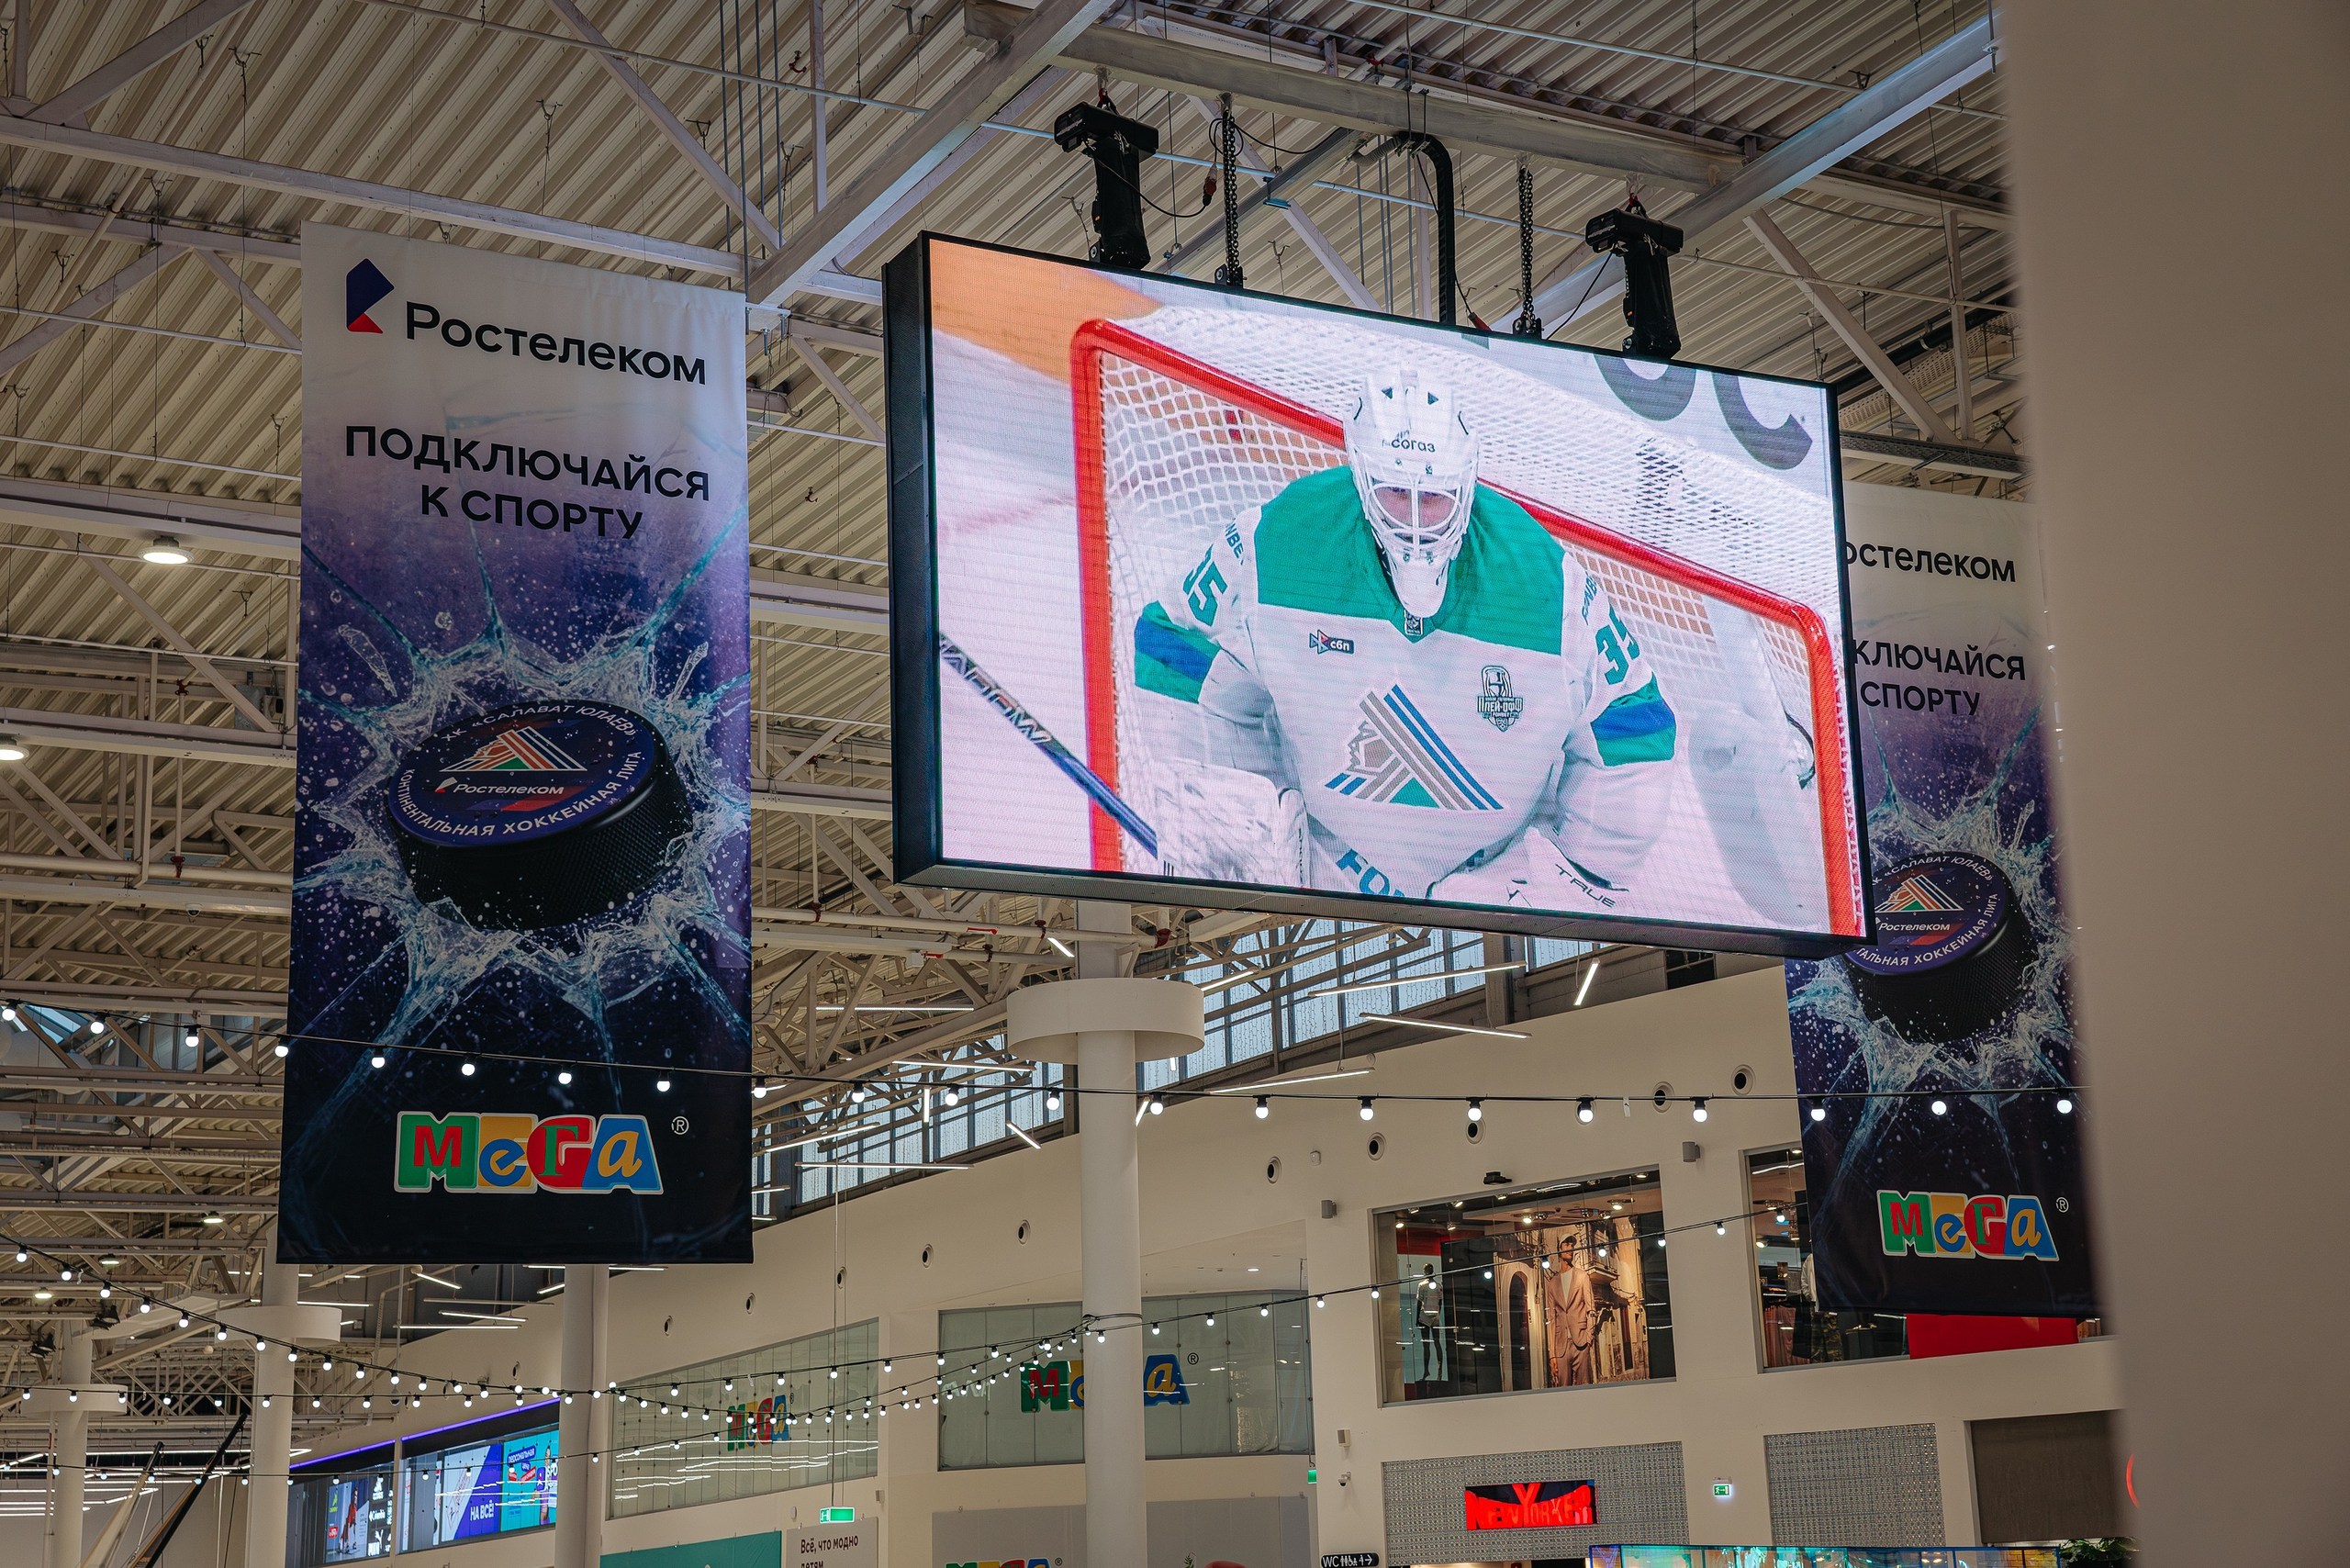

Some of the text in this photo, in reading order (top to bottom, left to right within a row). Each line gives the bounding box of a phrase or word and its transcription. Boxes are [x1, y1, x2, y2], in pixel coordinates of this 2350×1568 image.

[405, 300, 707, 386] Ростелеком
[345, 425, 710, 501] ПОДКЛЮЧАЙСЯ
[420, 484, 643, 540] К СПОРТУ
[1845, 541, 2017, 583] остелеком
[1852, 639, 2026, 681] КЛЮЧАЙСЯ
[1860, 681, 1980, 715] СПОРТУ
[397, 750, 643, 836] КОНТИНЕНТАЛЬНАЯ ХОККЕЙНАЯ ЛИГА
[453, 783, 565, 796] Ростелеком
[1555, 864, 1616, 908] TRUE
[1879, 923, 1951, 932] Ростелеком
[1914, 919, 1988, 965] ХОККЕЙНАЯ
[1984, 892, 1998, 919] ЛИГА
[800, 1535, 859, 1554] Всё, что модно
[1322, 1555, 1339, 1568] WC
